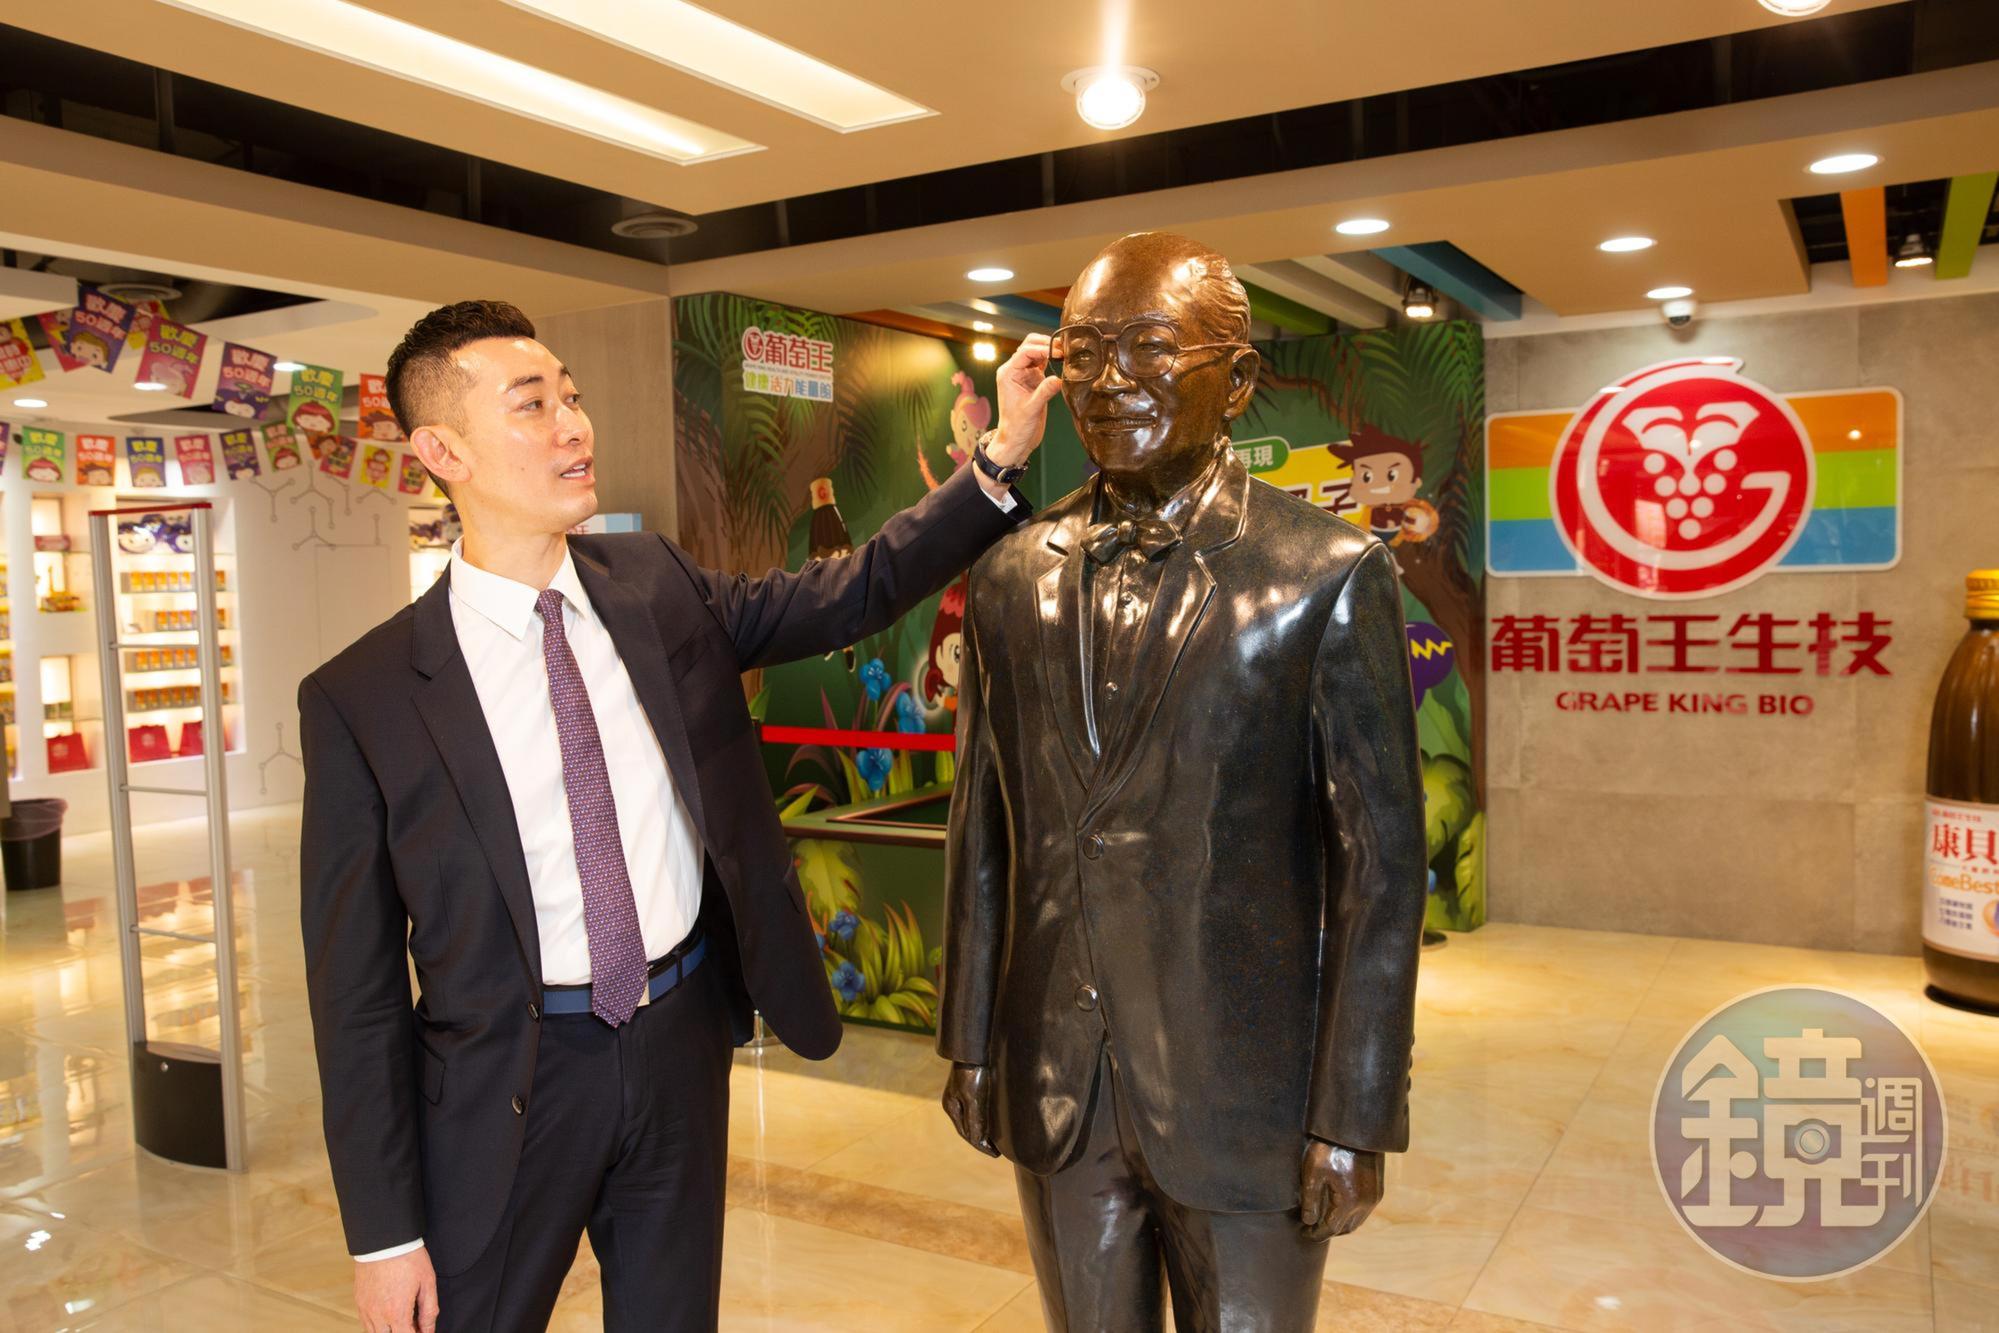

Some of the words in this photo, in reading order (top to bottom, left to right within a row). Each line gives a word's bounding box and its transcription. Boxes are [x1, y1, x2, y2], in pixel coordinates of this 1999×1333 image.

[765, 333, 832, 374] 葡萄王
[1491, 612, 1893, 677] 葡萄王生技
[1555, 691, 1660, 713] GRAPE
[1669, 693, 1748, 715] KING
[1758, 694, 1815, 716] BIO
